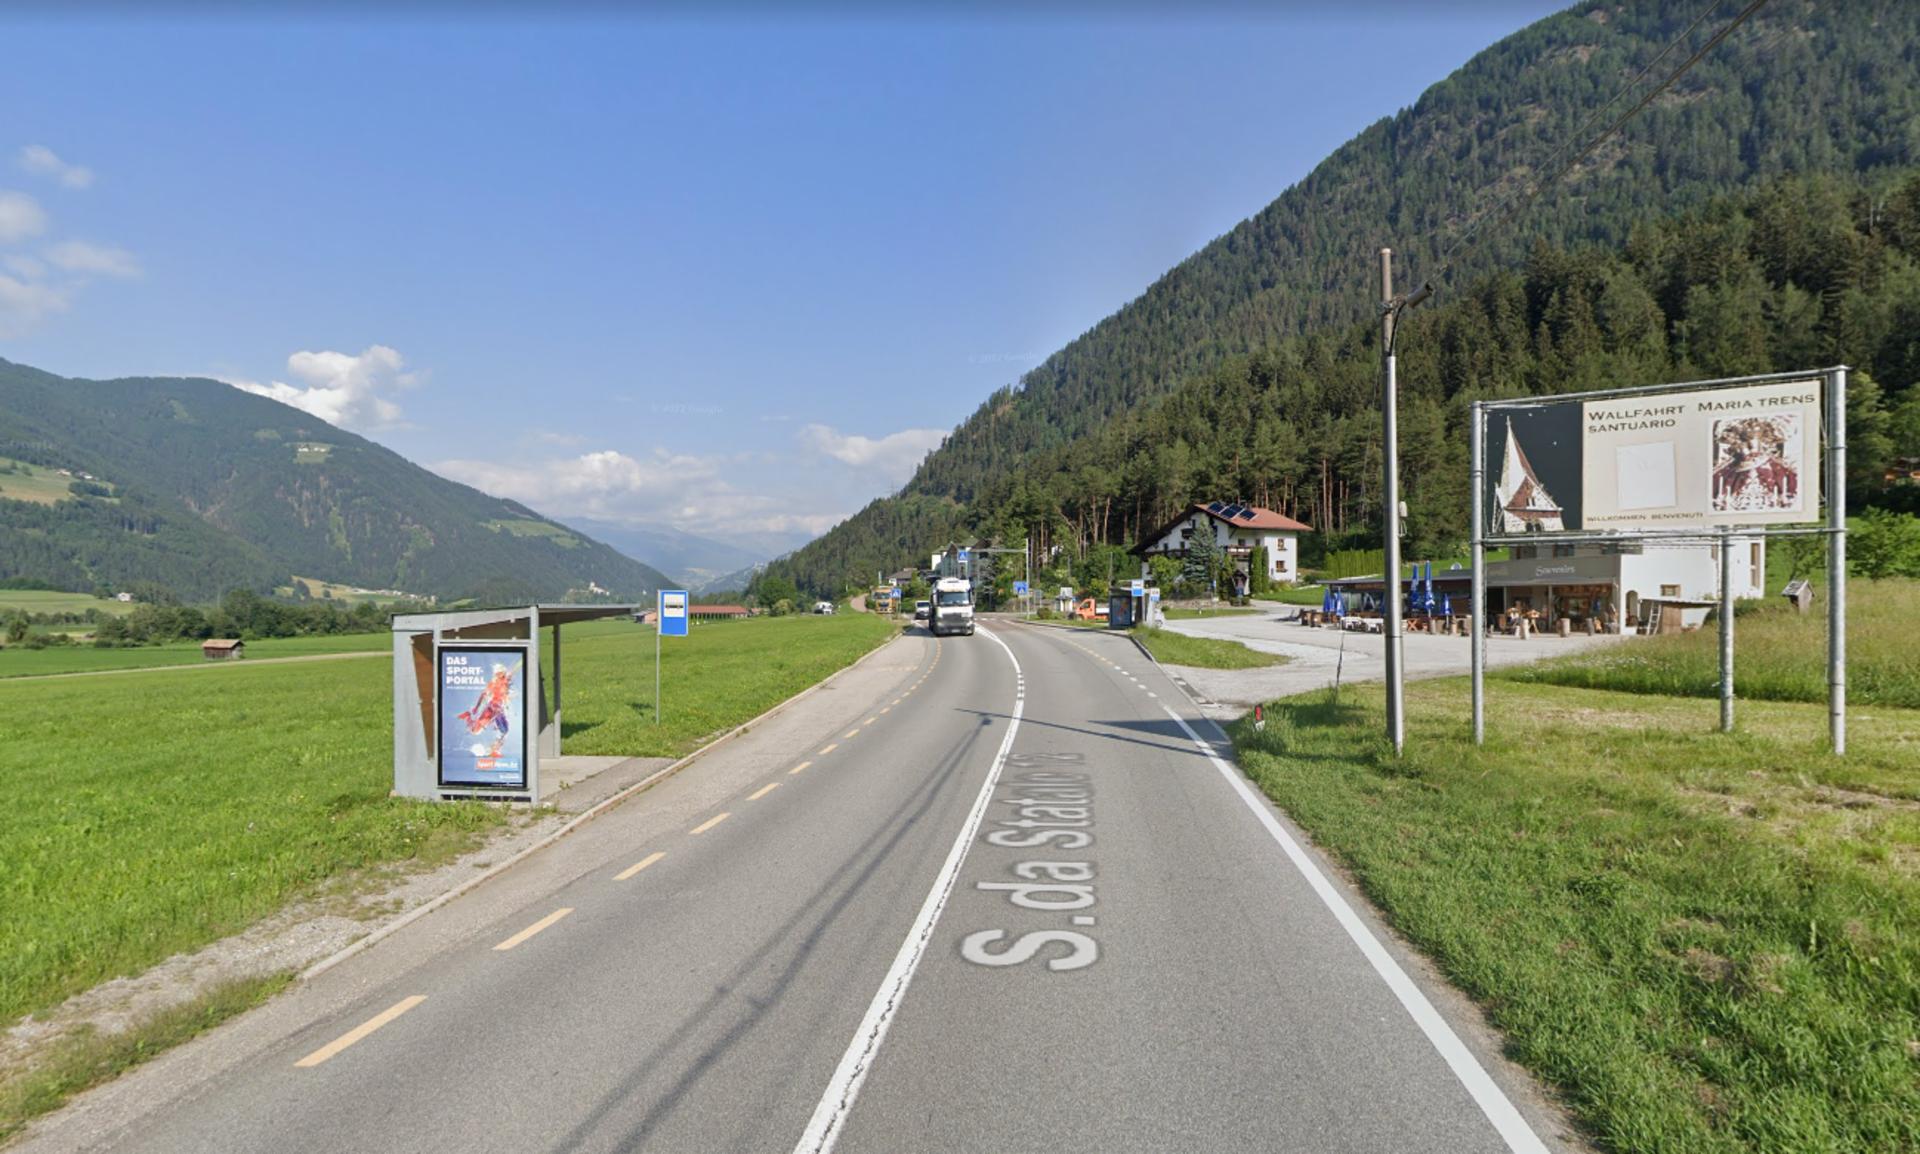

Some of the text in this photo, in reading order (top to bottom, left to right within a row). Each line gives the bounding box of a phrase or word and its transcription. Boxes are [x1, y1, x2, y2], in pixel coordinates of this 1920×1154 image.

[1588, 394, 1816, 421] WALLFAHRT MARIA TRENS
[1588, 418, 1676, 433] SANTUARIO
[1651, 512, 1704, 520] BENVENUTI
[446, 656, 467, 665] DAS
[446, 666, 485, 675] SPORT-
[446, 676, 486, 685] PORTAL
